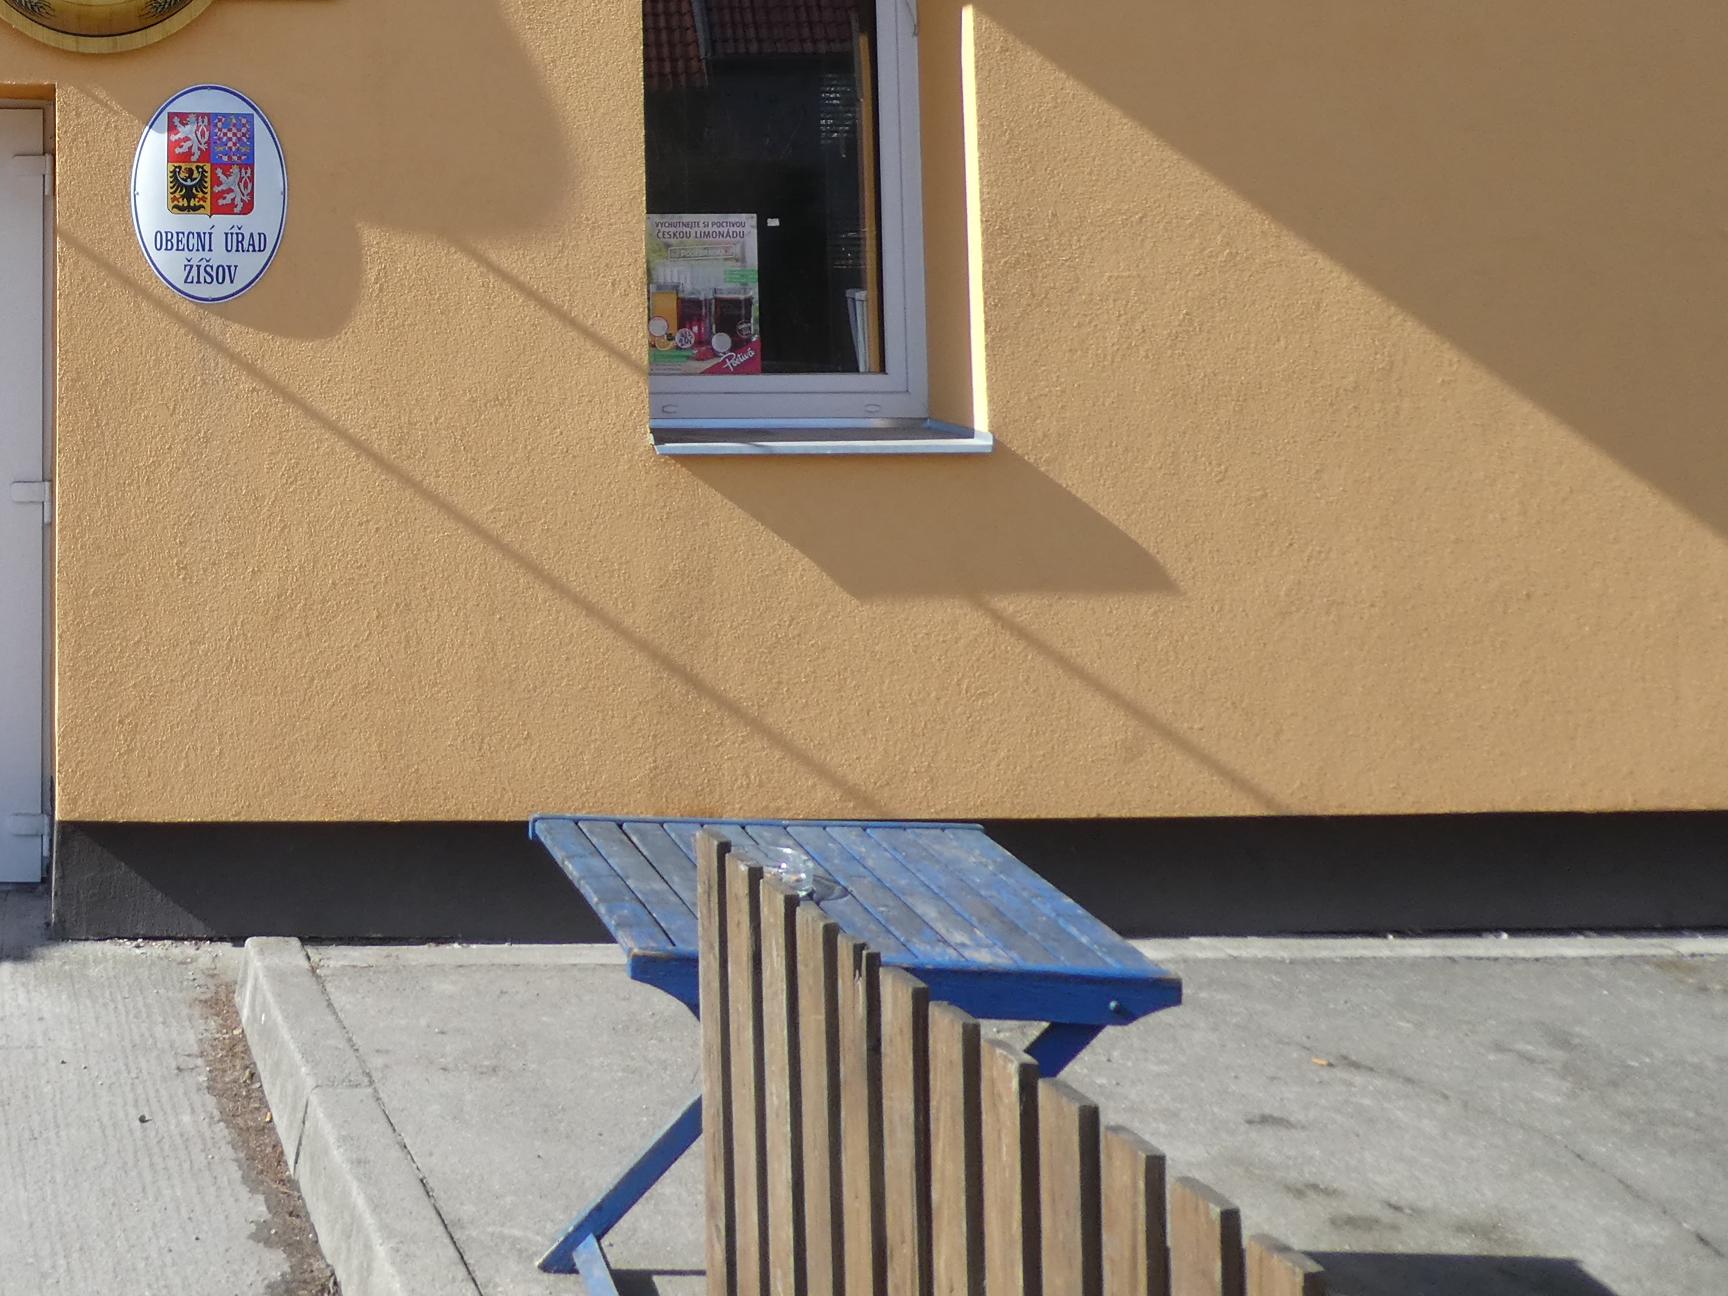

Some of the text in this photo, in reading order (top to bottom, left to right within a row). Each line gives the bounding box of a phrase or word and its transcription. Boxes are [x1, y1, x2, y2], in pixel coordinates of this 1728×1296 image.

[655, 221, 701, 229] VYCHUTNEJTE
[656, 228, 745, 239] ČESKOU LIMONÁDU
[154, 225, 267, 253] OBECNÍ ÚŘAD
[183, 257, 238, 284] ŽÍŠOV
